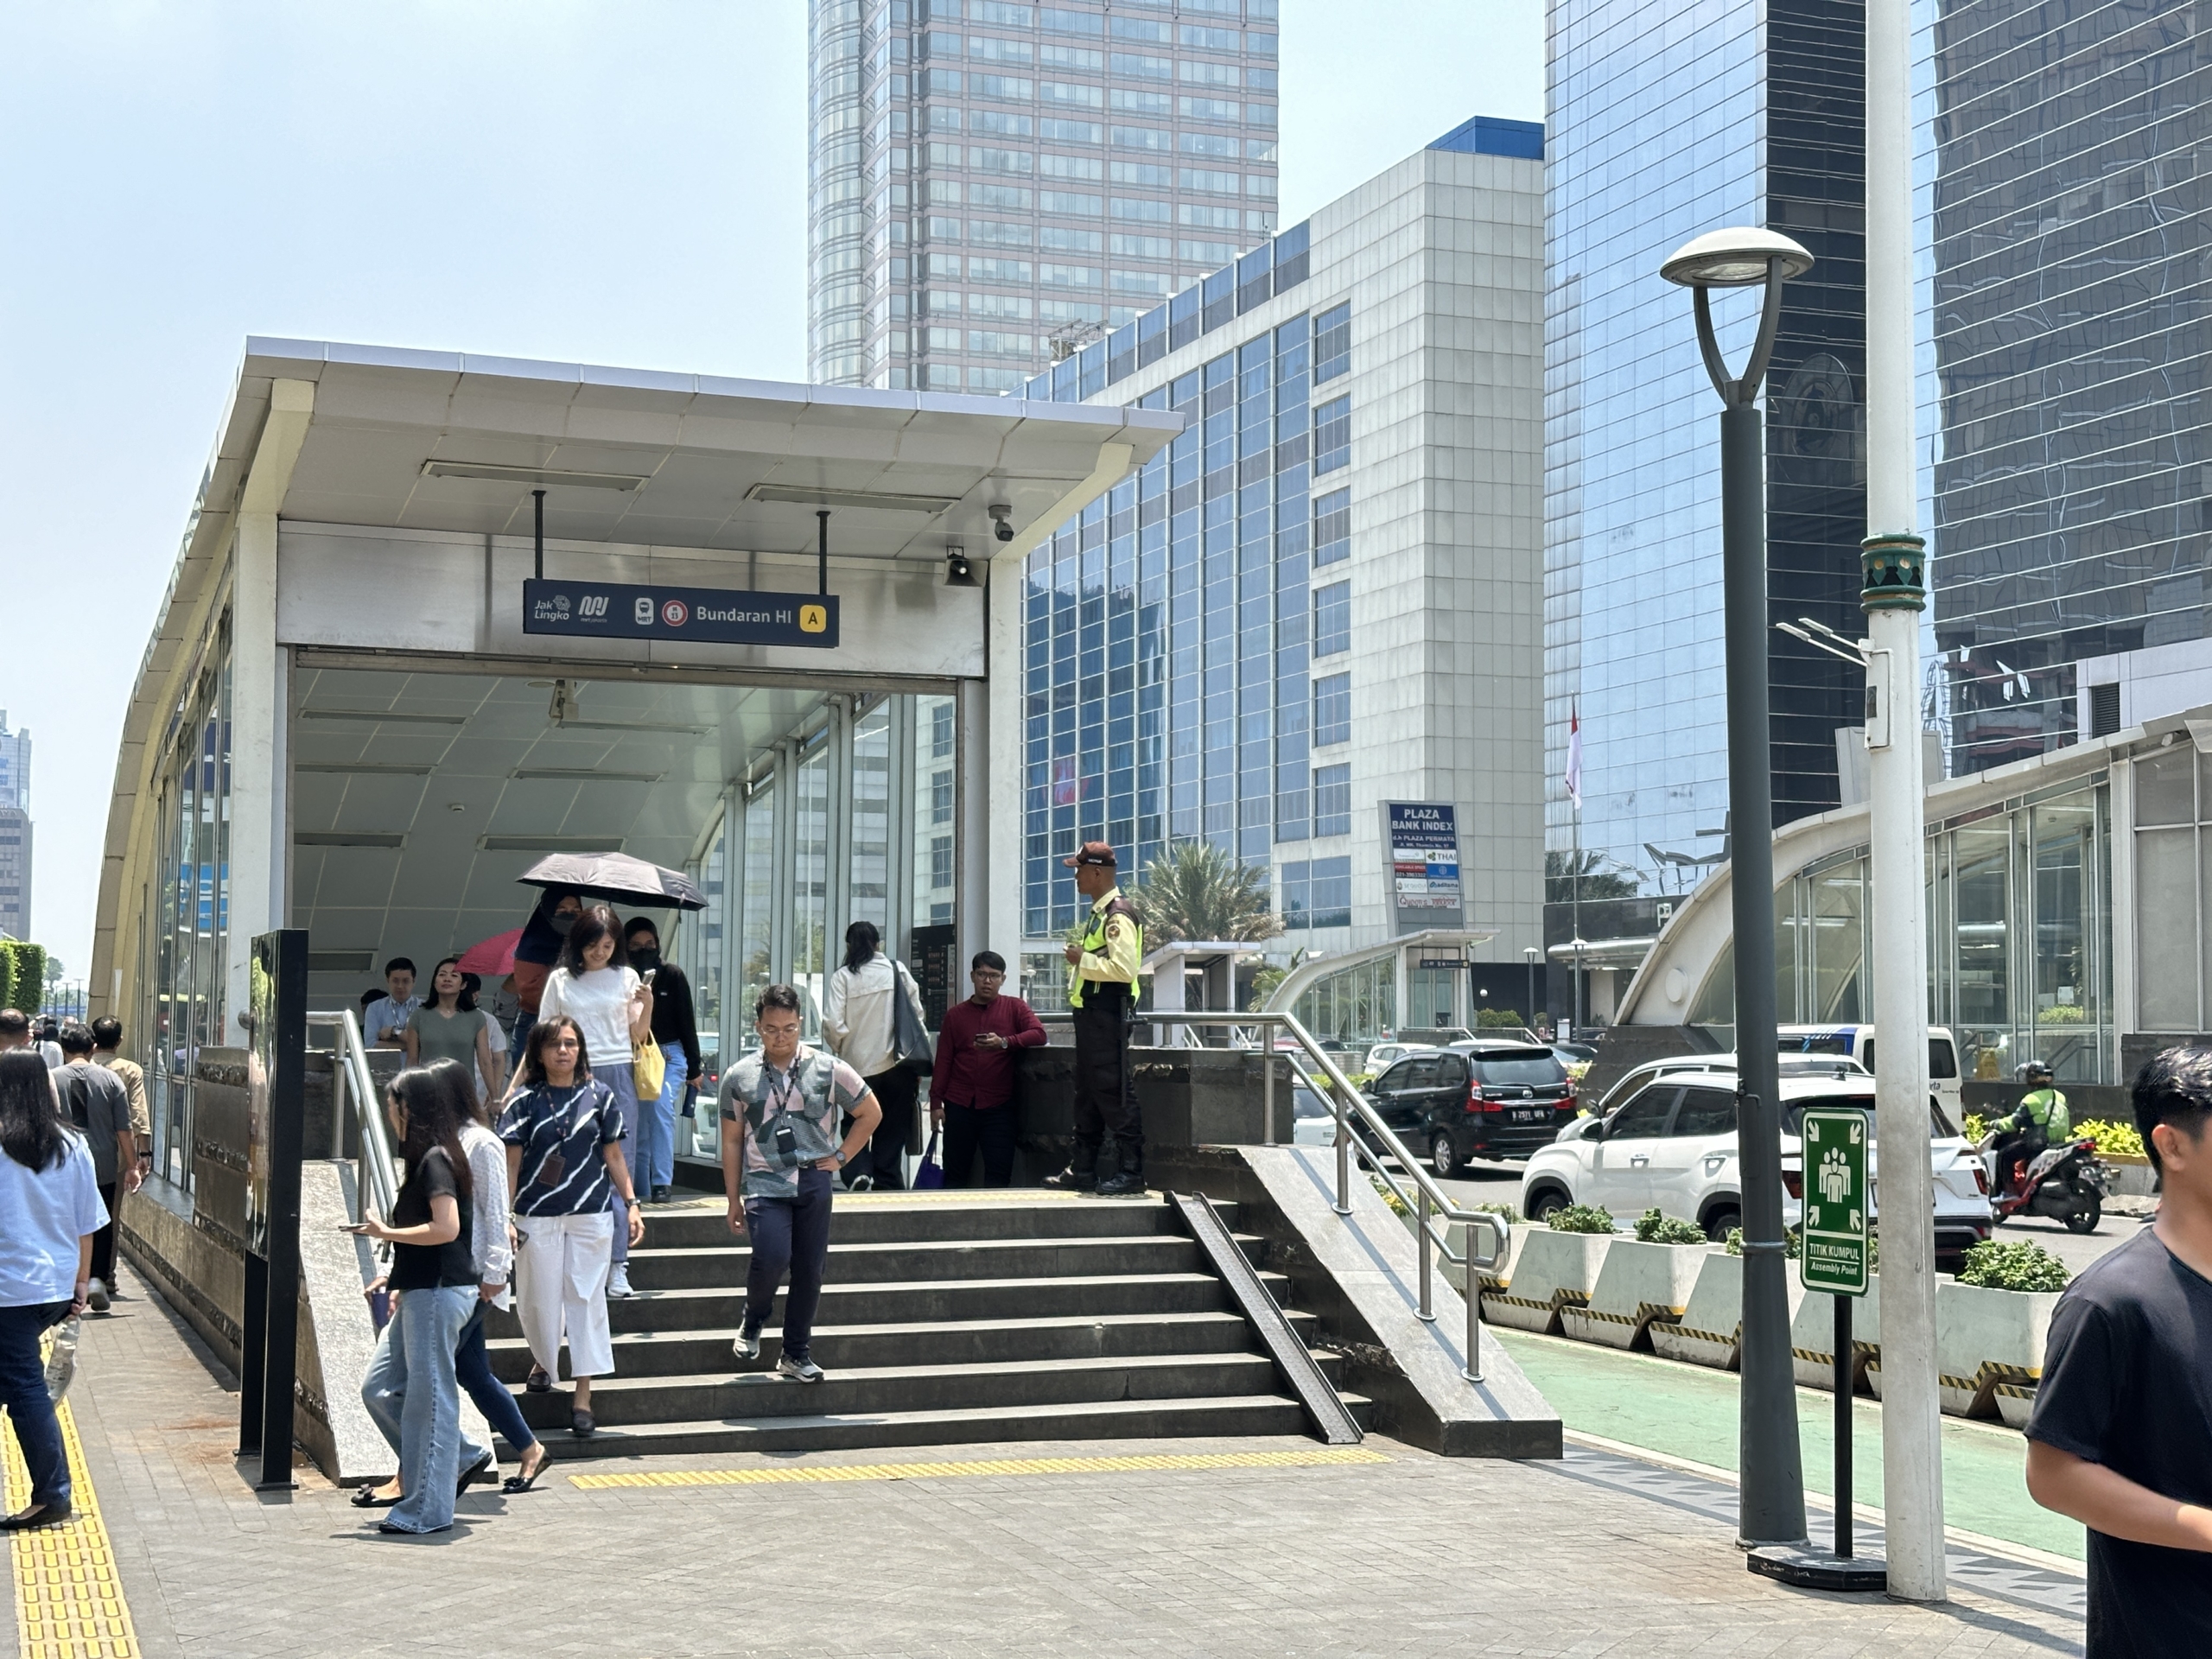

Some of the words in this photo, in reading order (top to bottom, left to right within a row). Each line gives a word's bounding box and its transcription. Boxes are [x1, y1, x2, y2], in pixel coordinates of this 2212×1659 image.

[534, 600, 554, 610] Jak
[534, 609, 570, 622] Lingko
[696, 606, 771, 623] Bundaran
[775, 609, 791, 624] HI
[807, 611, 818, 625] A
[1404, 809, 1440, 820] PLAZA
[1391, 820, 1421, 830] BANK
[1421, 821, 1453, 831] INDEX
[1808, 1243, 1827, 1256] TITIK
[1828, 1244, 1859, 1260] KUMPUL
[1810, 1261, 1840, 1275] Assembly
[1840, 1264, 1858, 1275] Point
